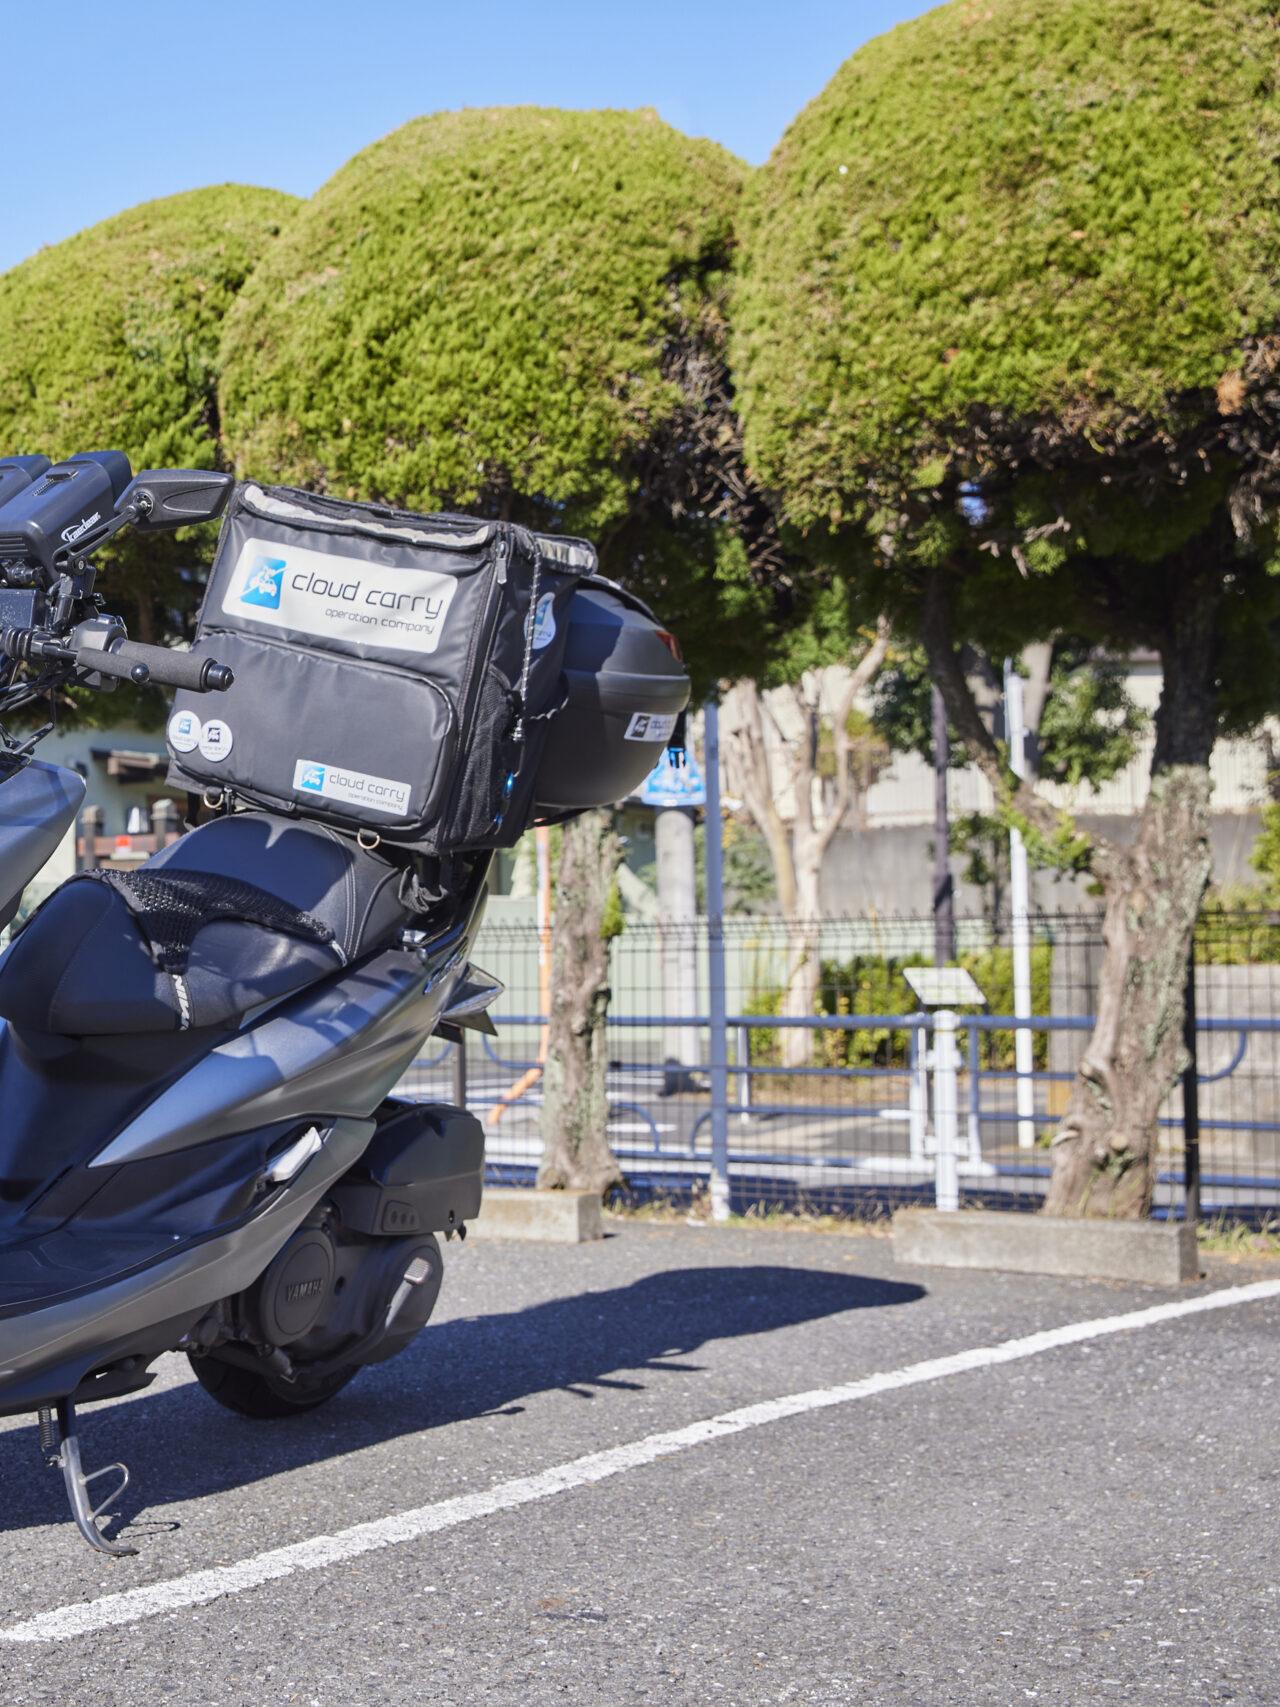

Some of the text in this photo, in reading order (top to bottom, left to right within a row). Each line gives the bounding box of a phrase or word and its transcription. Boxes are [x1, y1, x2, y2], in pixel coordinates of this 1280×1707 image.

[292, 572, 444, 620] cloud carry
[325, 607, 435, 634] operation company
[329, 773, 406, 803] cloud carry
[286, 1279, 324, 1302] YAMAHA
